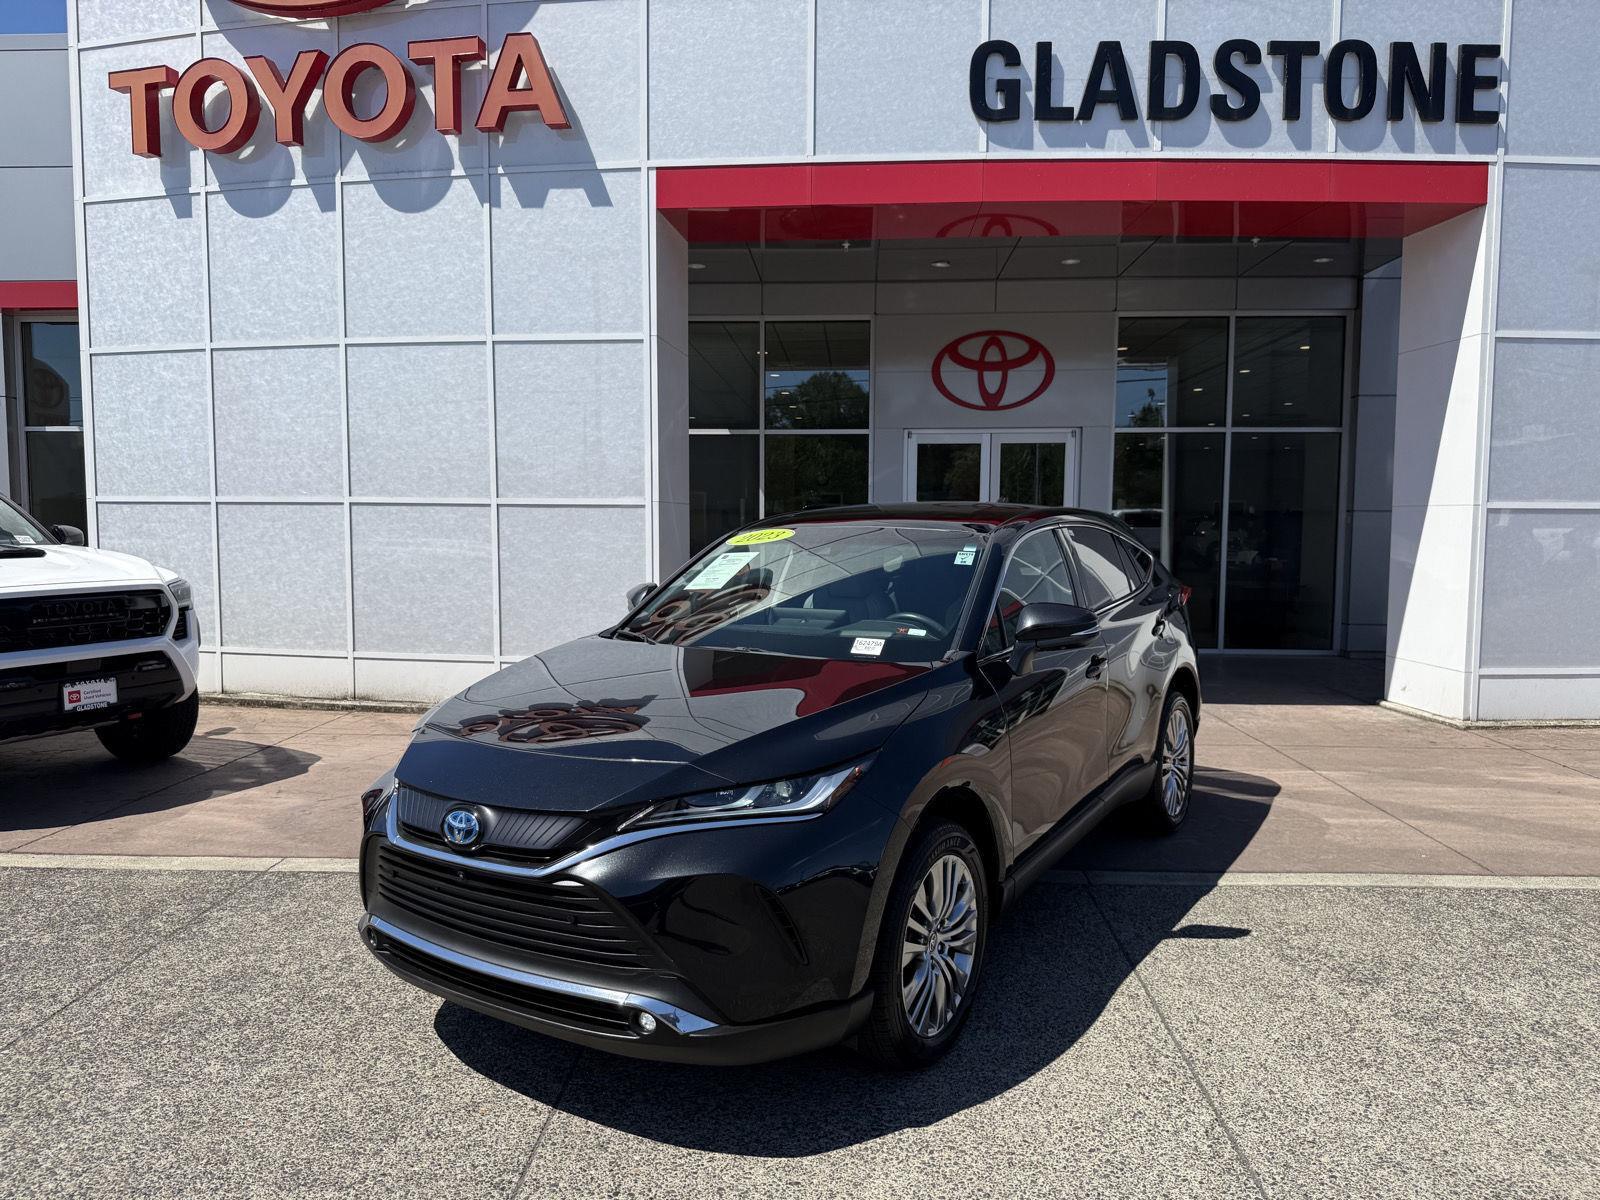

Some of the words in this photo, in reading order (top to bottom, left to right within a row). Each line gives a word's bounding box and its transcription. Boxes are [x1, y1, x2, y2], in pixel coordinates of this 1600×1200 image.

[970, 39, 1501, 125] GLADSTONE
[108, 33, 571, 158] TOYOTA
[44, 600, 117, 616] TOYOTA
[75, 678, 105, 686] TOYOTA
[77, 702, 108, 712] GLADSTONE
